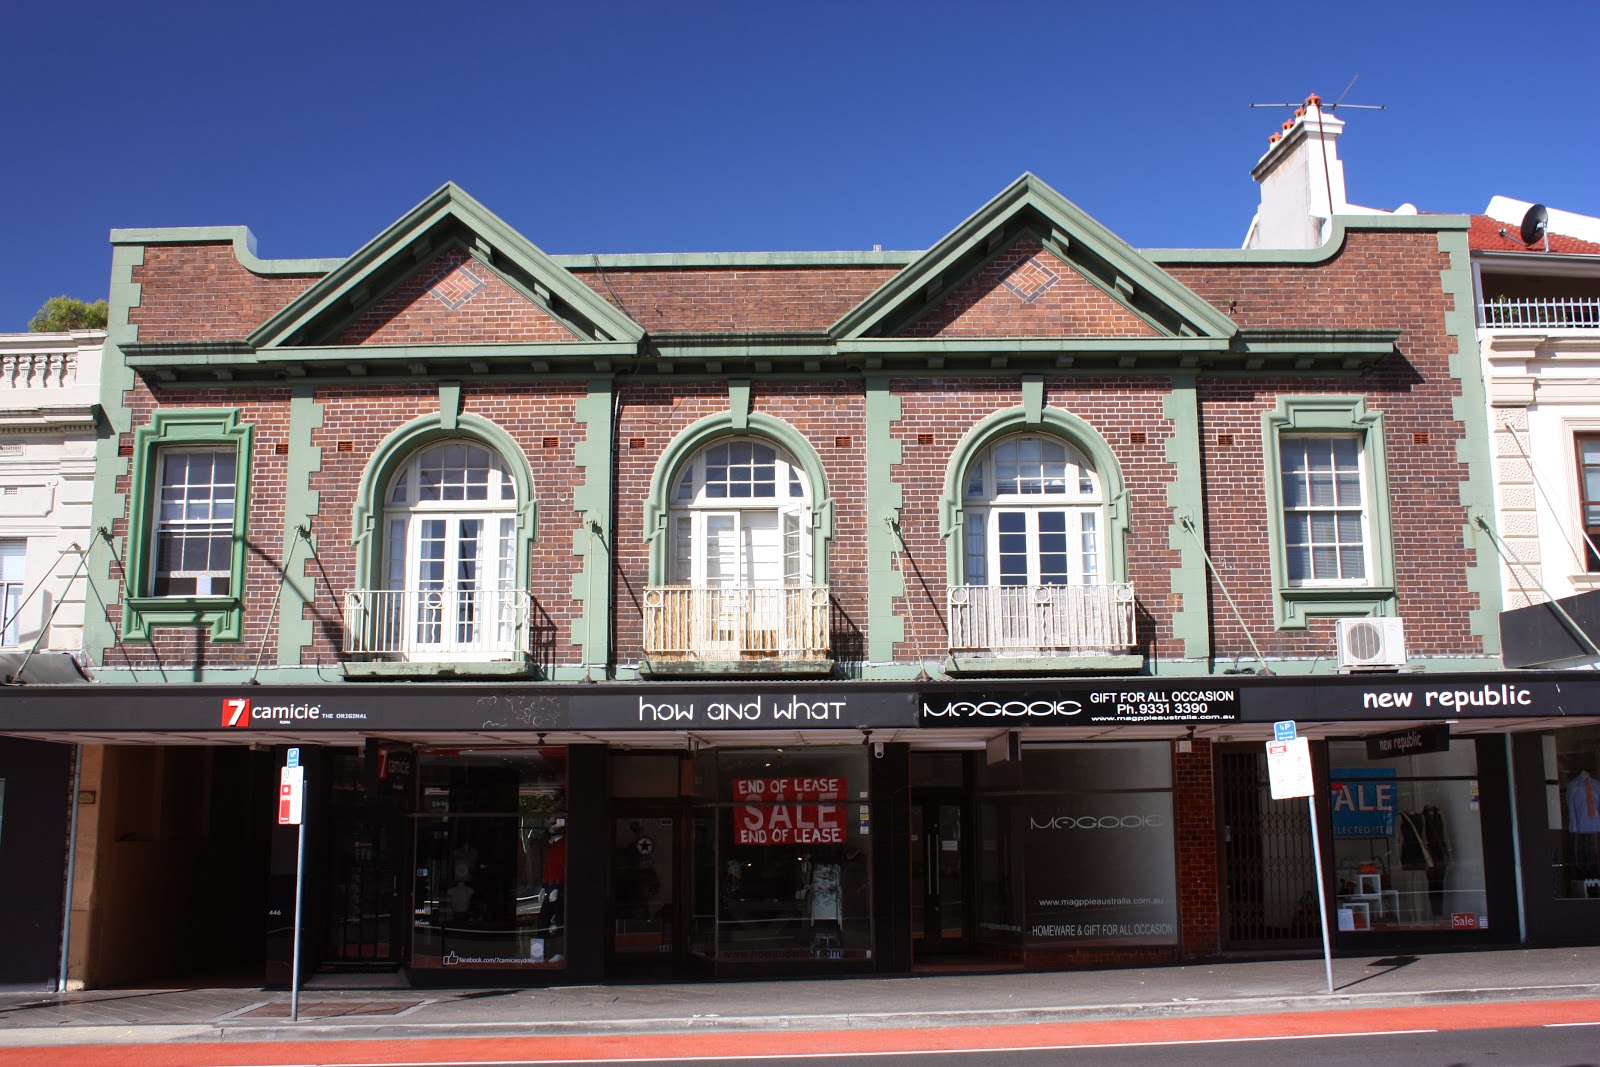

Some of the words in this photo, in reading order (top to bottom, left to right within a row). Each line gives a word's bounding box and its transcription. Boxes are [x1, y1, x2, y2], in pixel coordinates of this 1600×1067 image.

[1090, 692, 1117, 703] GIFT
[1120, 692, 1146, 702] FOR
[1147, 691, 1169, 702] ALL
[1171, 690, 1235, 702] OCCASION
[1363, 692, 1413, 708] new
[1425, 684, 1532, 712] republic
[228, 700, 246, 726] 7
[252, 704, 320, 719] camicie
[639, 696, 694, 721] how
[1174, 703, 1208, 714] 3390
[1091, 714, 1235, 722] www.magppieaustralia.com.au
[1379, 740, 1392, 751] new
[1393, 730, 1422, 752] republic
[738, 780, 765, 794] END
[770, 779, 788, 793] OF
[794, 779, 839, 792] LEASE
[1334, 784, 1393, 811] ALE
[744, 792, 838, 830] SALE
[740, 830, 767, 843] END
[771, 828, 790, 842] OF
[794, 828, 842, 842] LEASE
[1039, 897, 1164, 907] www.magppieaustralia.com.au
[1453, 915, 1474, 927] Sale
[1032, 925, 1076, 936] HOMEWARE
[1077, 925, 1082, 936] &
[1084, 925, 1101, 936] GIFT
[1102, 924, 1118, 935] FOR
[1119, 924, 1132, 935] ALL
[1134, 923, 1173, 935] OCCASION
